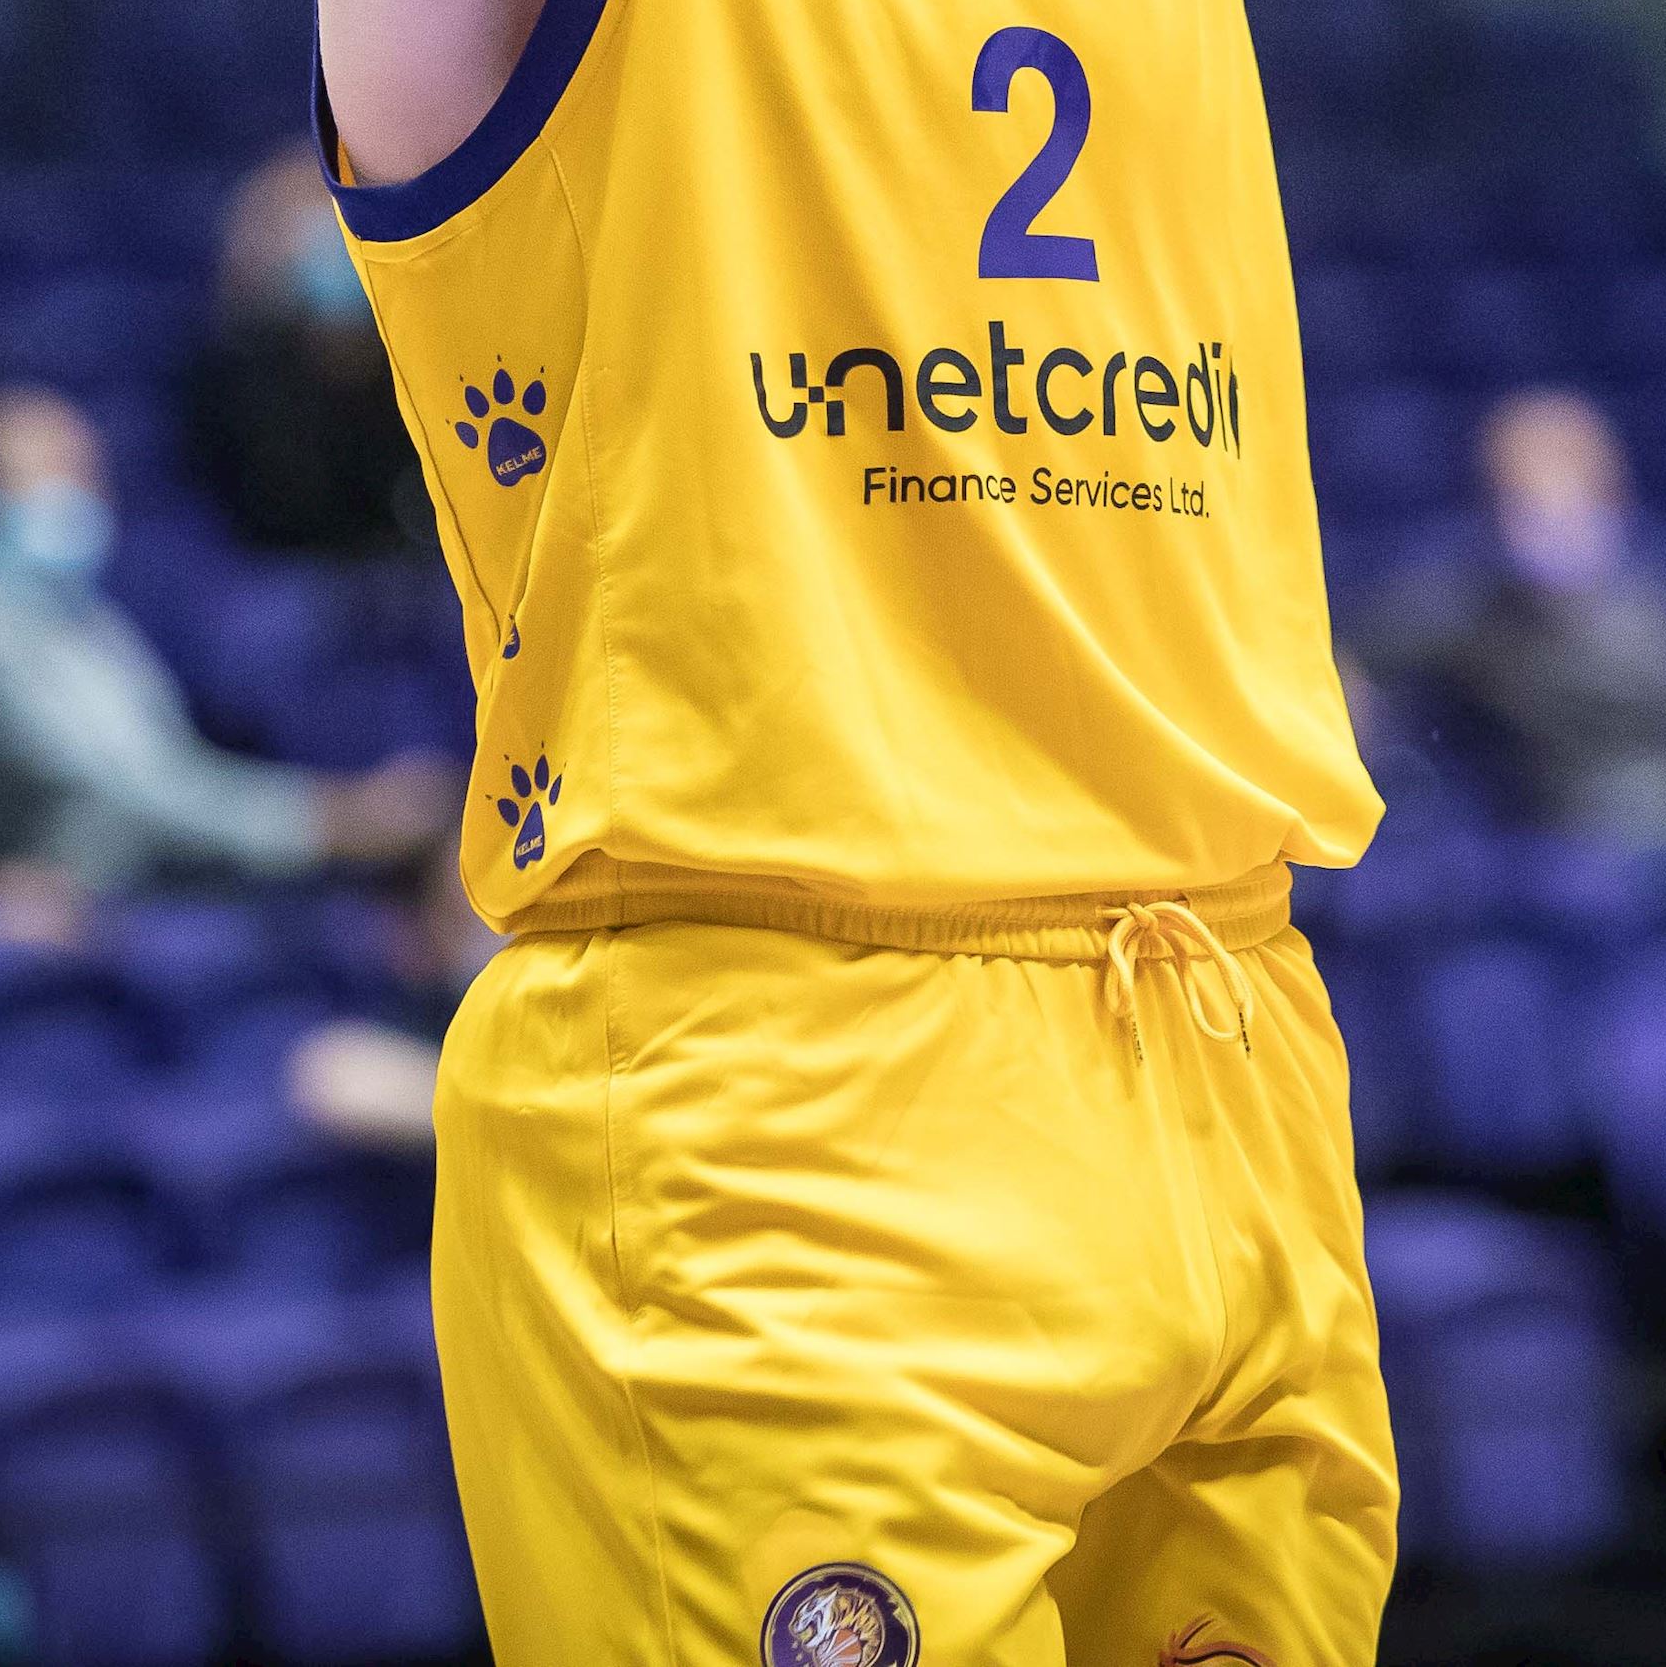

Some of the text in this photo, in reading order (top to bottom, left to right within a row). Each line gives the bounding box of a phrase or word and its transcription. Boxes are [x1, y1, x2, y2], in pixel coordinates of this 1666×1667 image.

[971, 25, 1100, 282] 2
[495, 445, 543, 476] KELME
[862, 466, 1210, 519] Finance Services Ltd.
